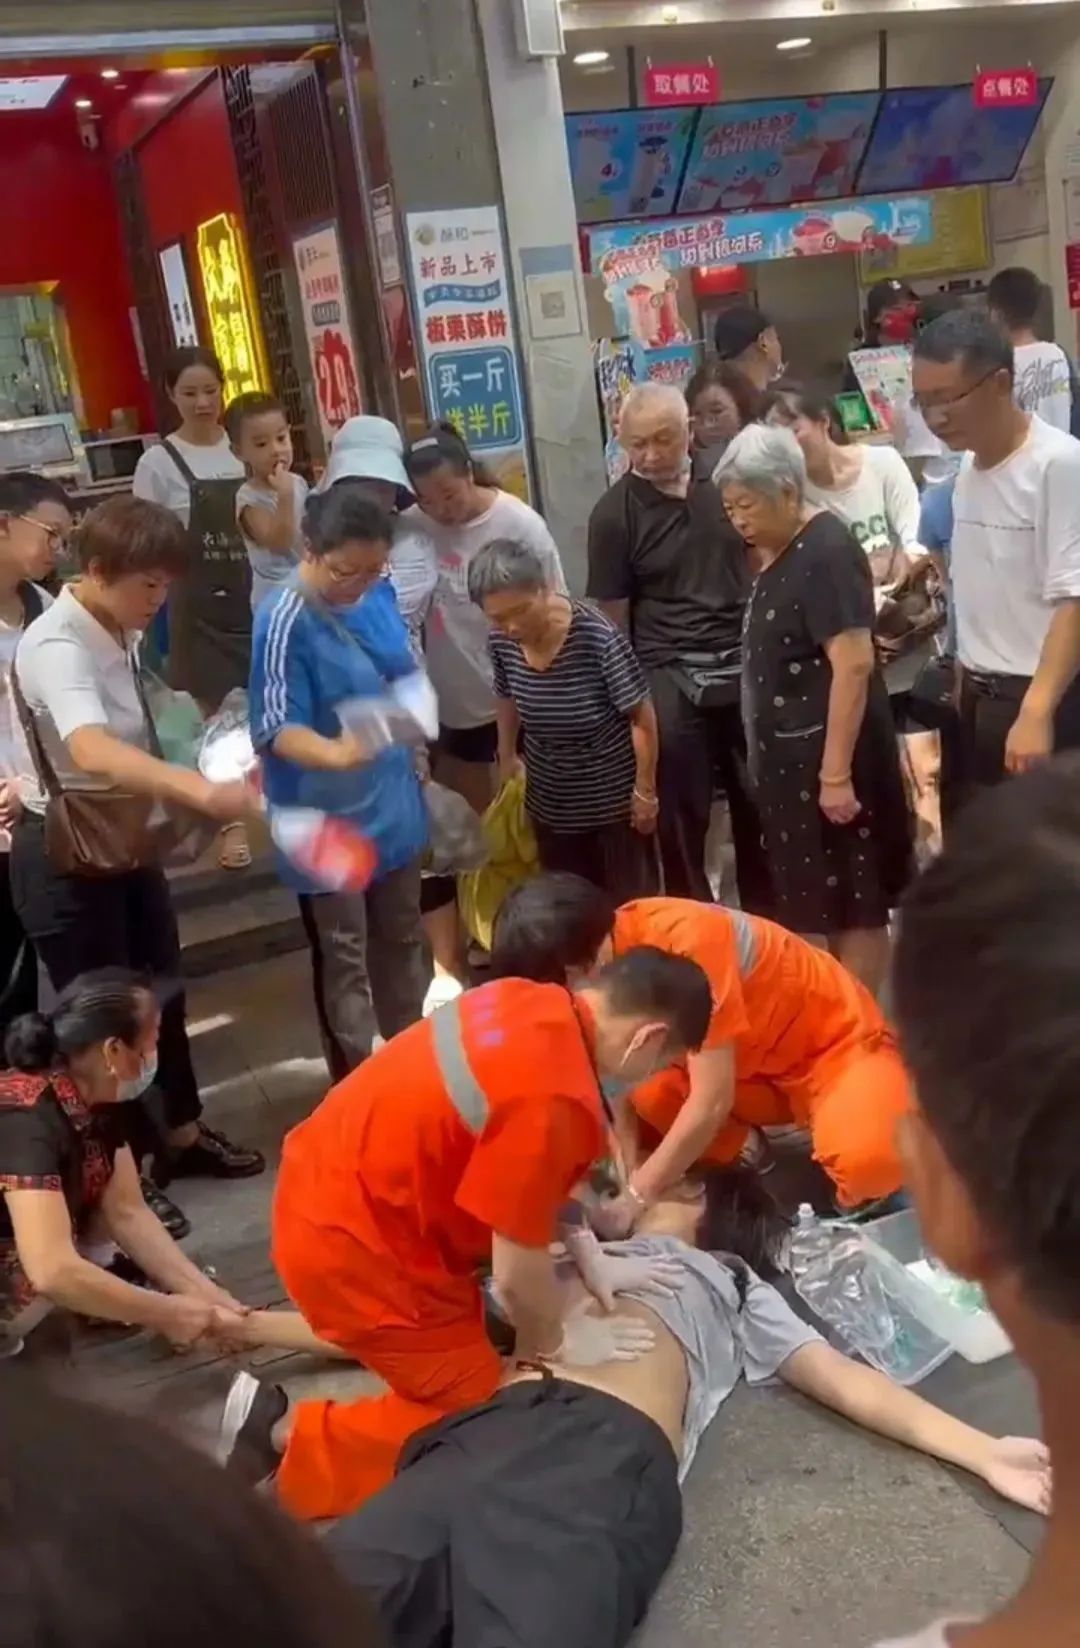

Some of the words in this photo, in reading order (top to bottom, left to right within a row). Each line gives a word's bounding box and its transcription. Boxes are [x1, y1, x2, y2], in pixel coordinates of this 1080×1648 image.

[653, 72, 710, 96] 取餐处
[983, 76, 1029, 97] 点餐处
[420, 250, 497, 279] 新品上市
[438, 357, 505, 399] 买一斤
